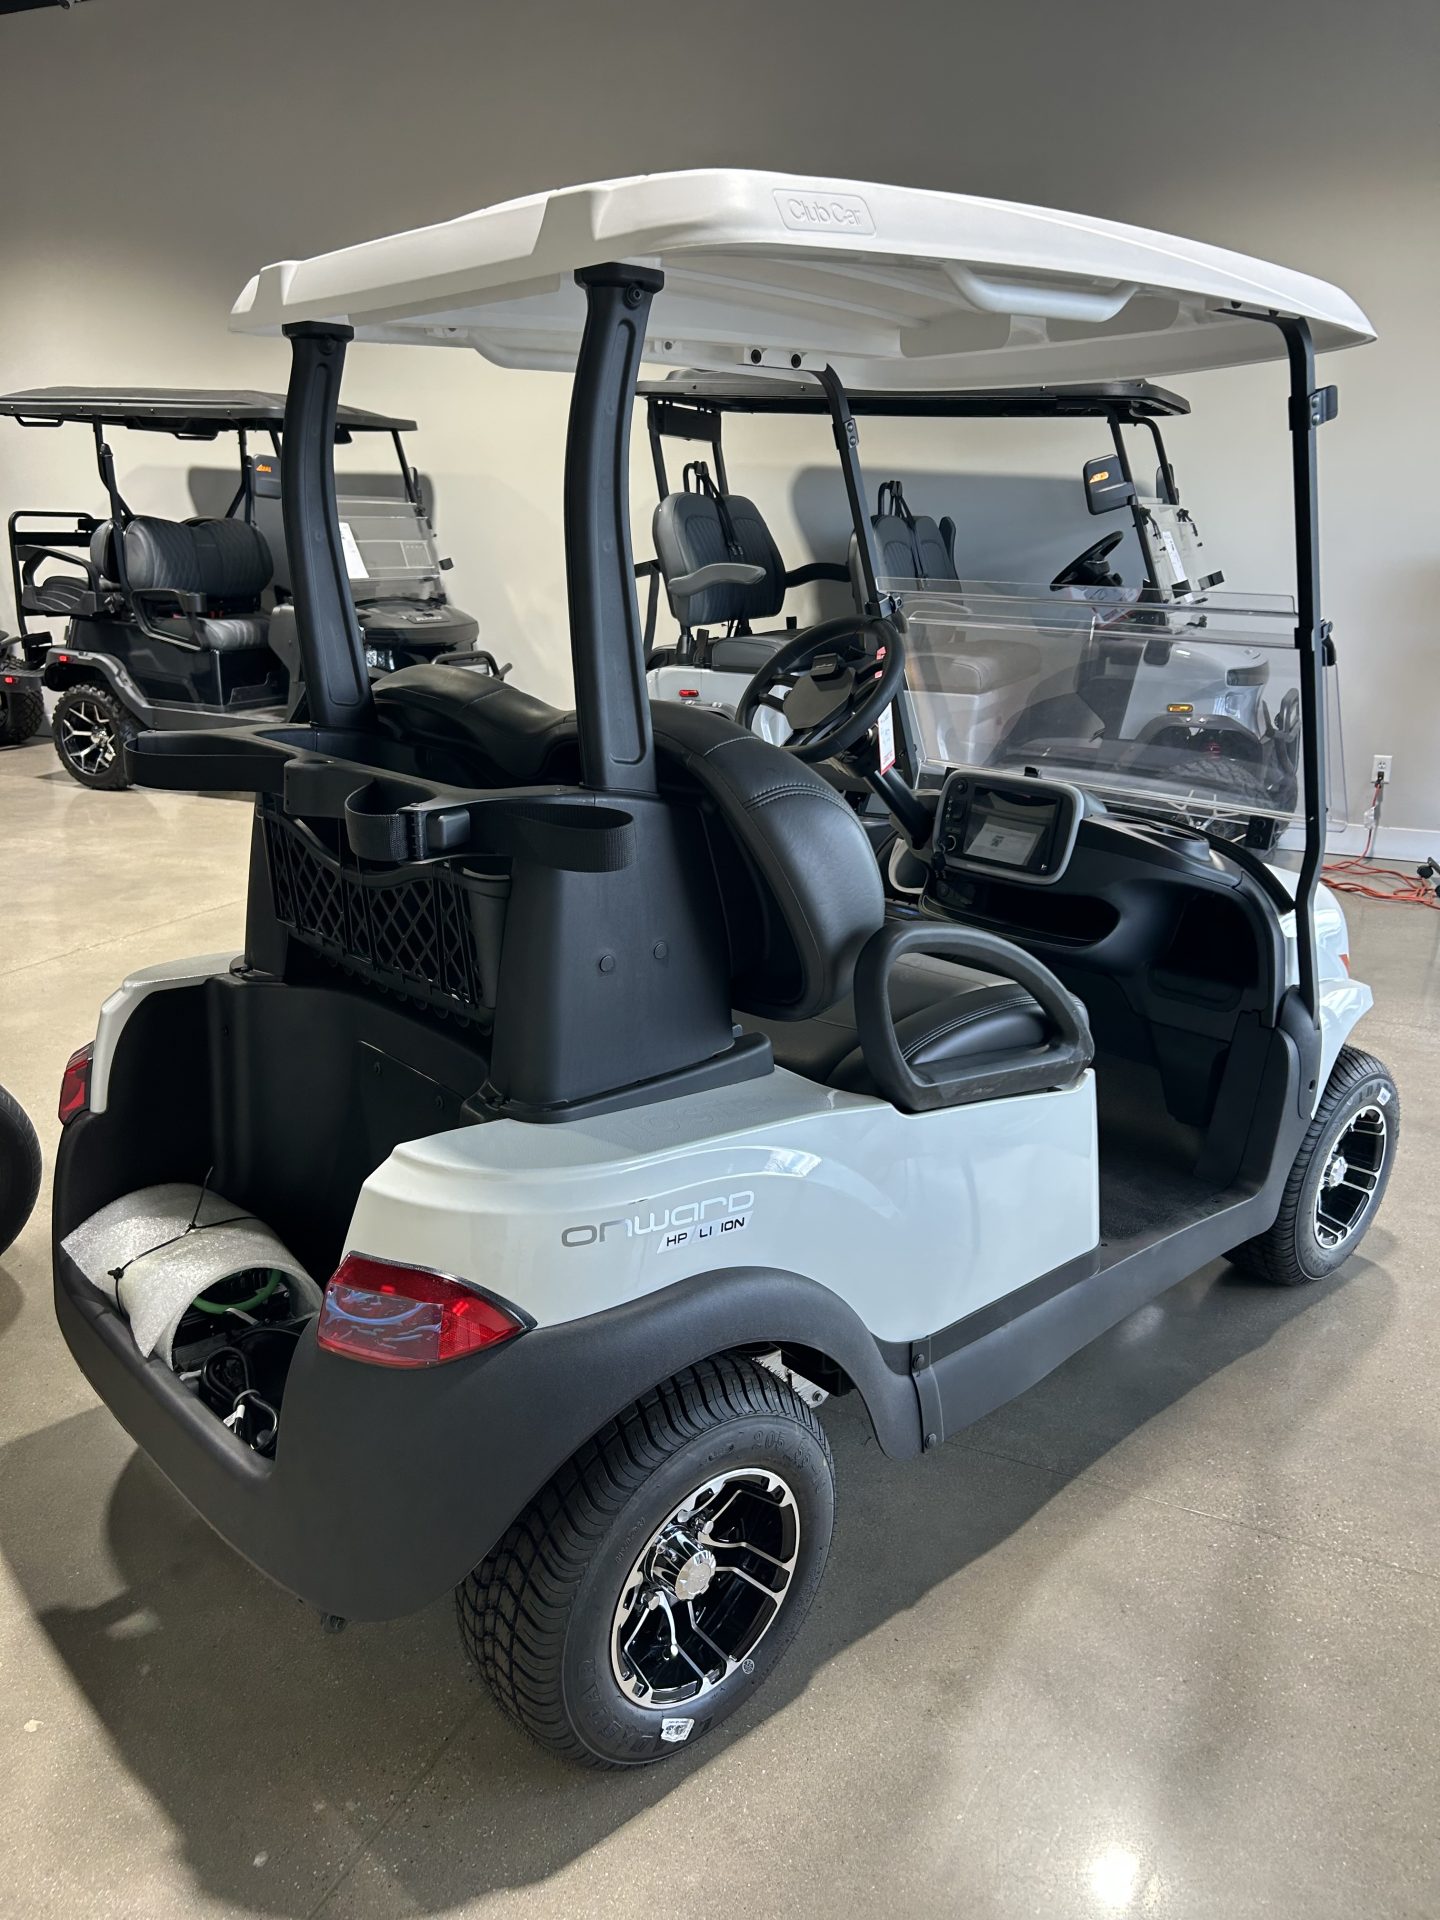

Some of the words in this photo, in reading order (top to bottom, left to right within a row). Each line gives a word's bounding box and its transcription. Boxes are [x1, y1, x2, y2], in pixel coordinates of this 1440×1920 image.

[788, 198, 831, 223] Club
[829, 202, 861, 225] Car
[666, 1232, 689, 1247] HP
[699, 1225, 713, 1239] LI
[720, 1217, 745, 1232] ION
